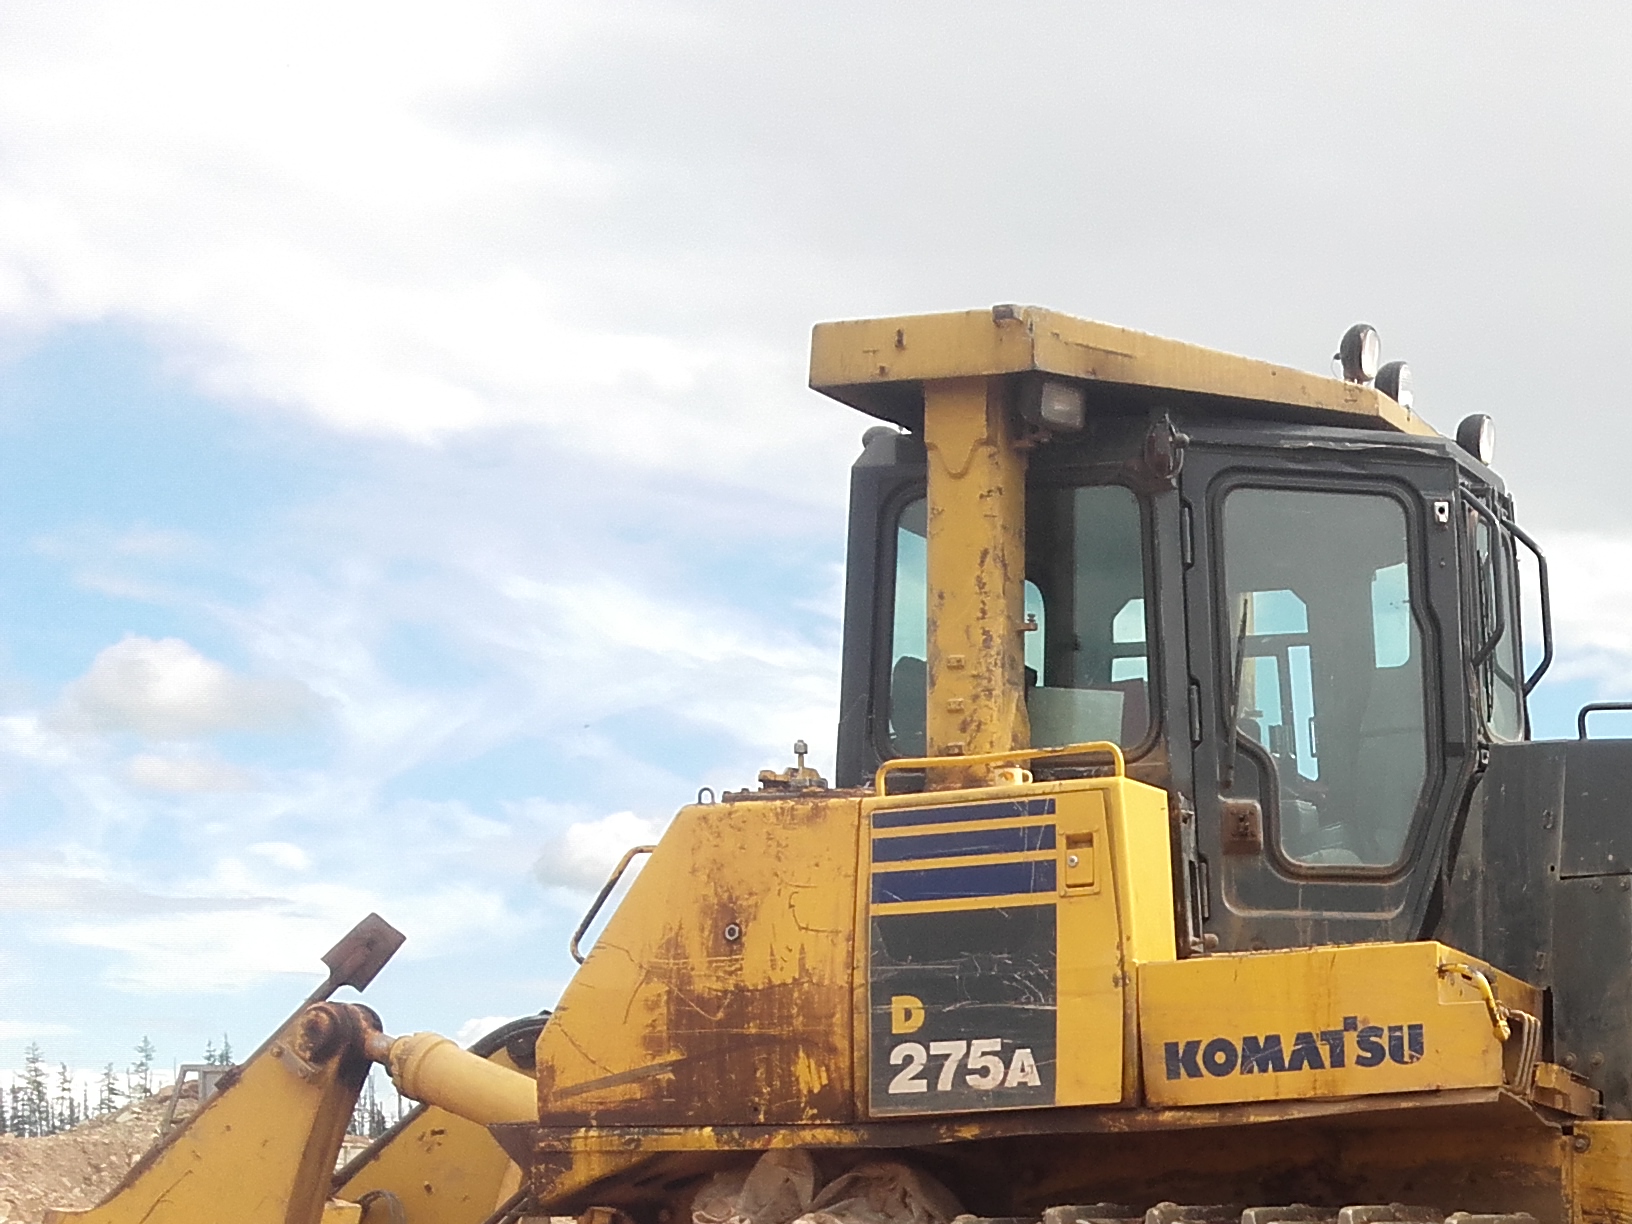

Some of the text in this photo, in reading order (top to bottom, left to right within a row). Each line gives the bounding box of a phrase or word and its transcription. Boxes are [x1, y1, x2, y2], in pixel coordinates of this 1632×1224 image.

[891, 995, 925, 1034] D
[888, 1038, 1041, 1094] 275A
[1164, 1016, 1424, 1081] KOMATSU
